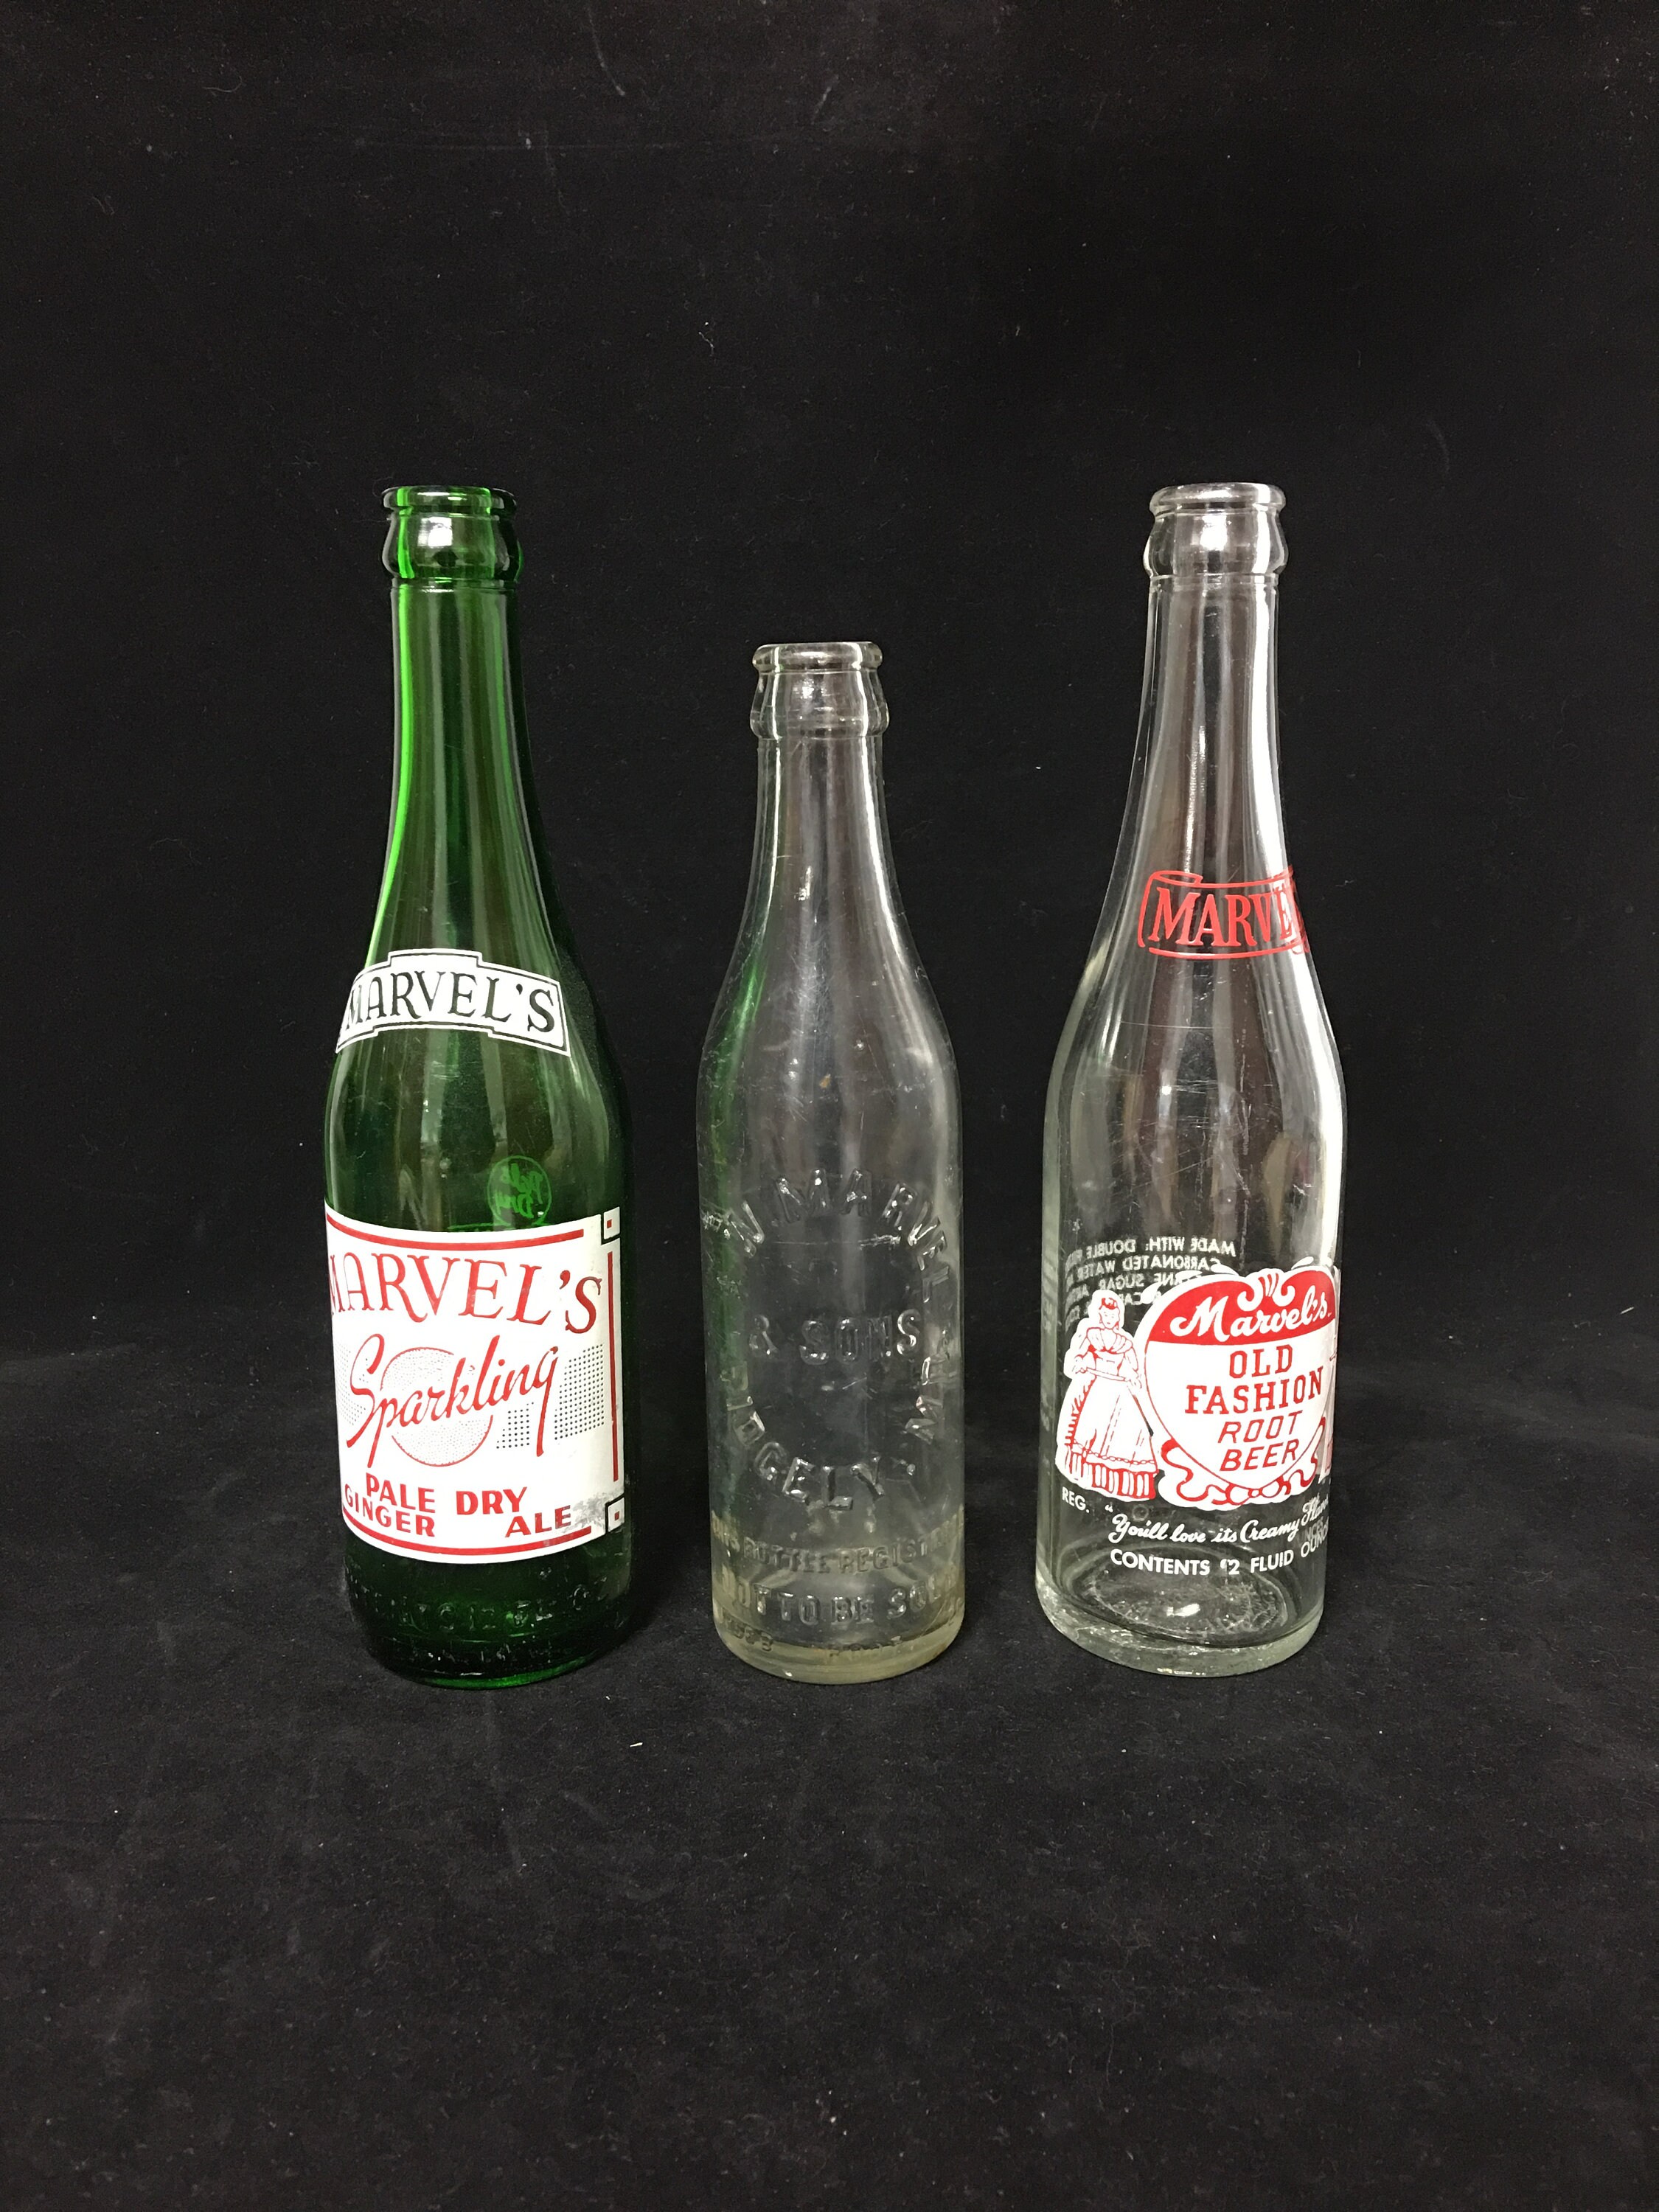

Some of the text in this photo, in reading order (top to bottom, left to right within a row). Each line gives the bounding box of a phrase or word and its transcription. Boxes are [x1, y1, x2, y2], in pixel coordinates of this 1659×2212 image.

[345, 970, 555, 1033] MARVEL'S
[328, 1251, 602, 1335] MARVEL'S
[1229, 1344, 1293, 1379] OLD
[346, 1332, 560, 1469] Sparkling
[1184, 1366, 1324, 1415] FASHION
[1217, 1410, 1304, 1444] ROOT
[1219, 1439, 1299, 1472] BEER
[344, 1483, 572, 1538] GINGER ALE
[365, 1472, 528, 1515] PALE DRY
[1062, 1486, 1090, 1514] REG.
[1169, 1528, 1206, 1543] love
[1211, 1527, 1238, 1543] its
[1241, 1518, 1300, 1543] Creamy
[1110, 1549, 1210, 1576] CONTENTS
[1251, 1549, 1294, 1573] FLUID
[776, 1590, 821, 1626] TO
[830, 1593, 875, 1625] BE
